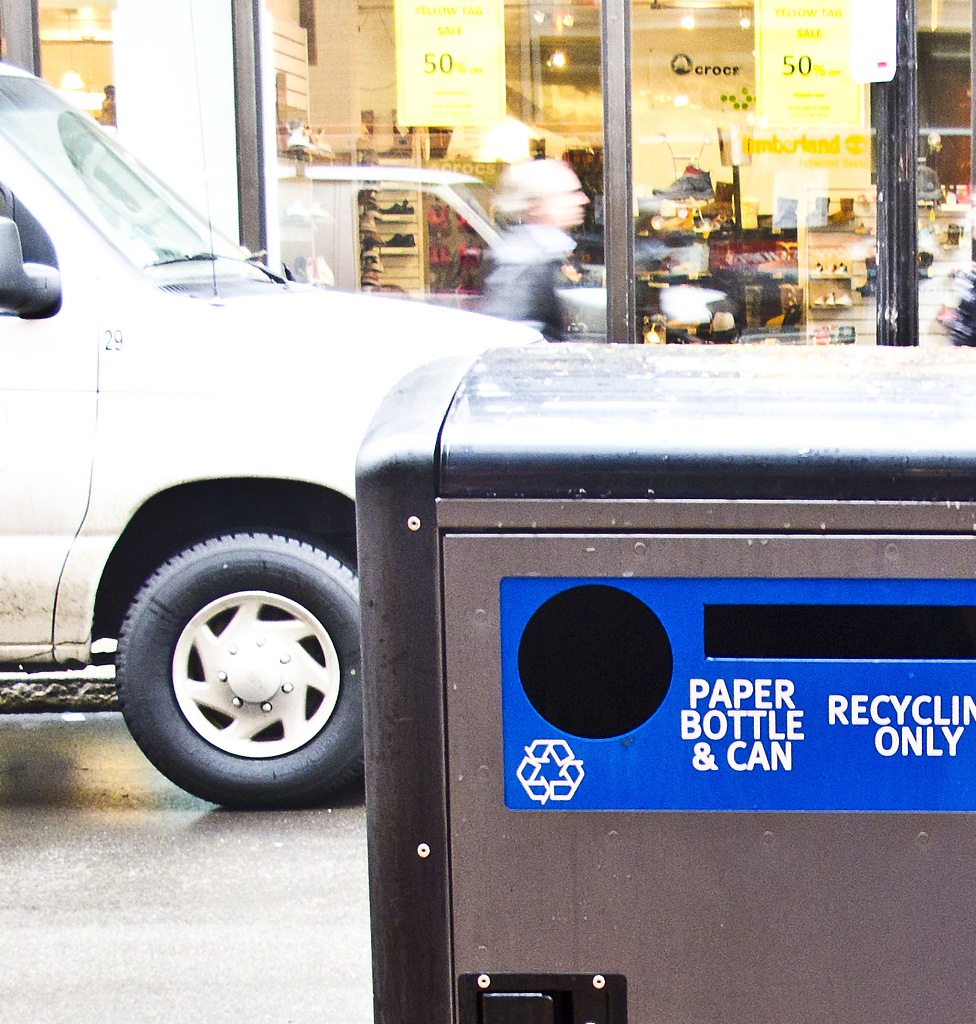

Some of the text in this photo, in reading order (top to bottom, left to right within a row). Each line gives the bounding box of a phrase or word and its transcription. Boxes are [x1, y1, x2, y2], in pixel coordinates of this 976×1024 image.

[415, 6, 483, 15] YELLOW TAG
[775, 8, 842, 17] YELLOW TAG
[437, 26, 462, 36] SALE
[797, 29, 822, 38] SALE
[104, 330, 123, 351] 29
[689, 678, 796, 709] PAPER
[680, 709, 805, 741] BOTTLE
[874, 726, 965, 757] ONLY
[692, 741, 792, 771] & CAN
